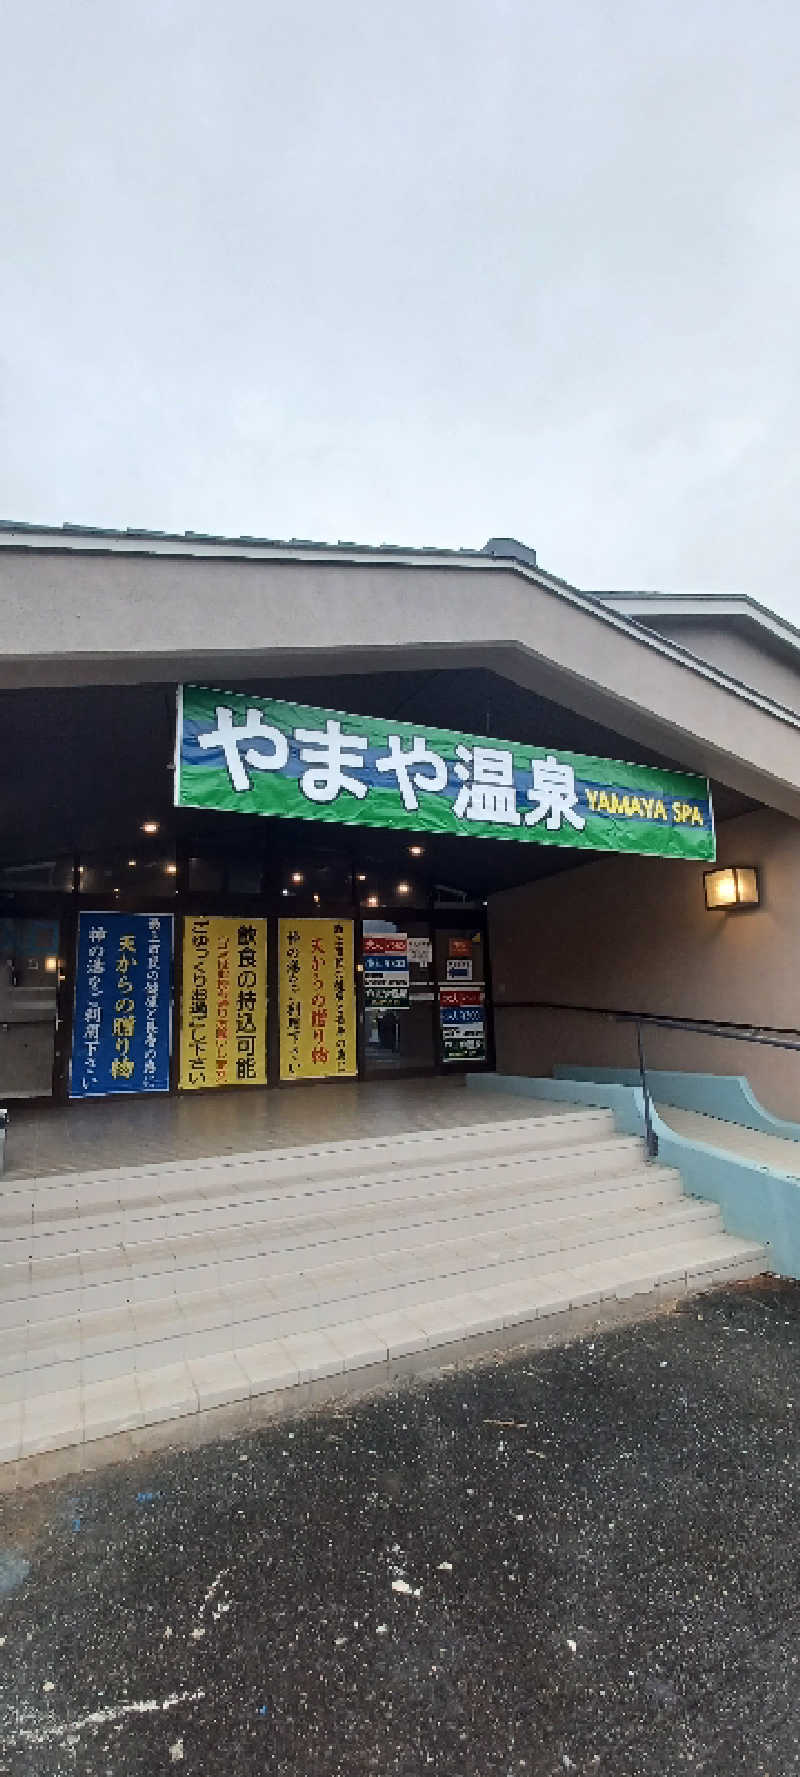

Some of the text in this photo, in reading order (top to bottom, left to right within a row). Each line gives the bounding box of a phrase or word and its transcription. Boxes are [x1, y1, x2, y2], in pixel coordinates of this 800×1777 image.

[197, 706, 587, 832] やまや温泉
[585, 788, 704, 826] YAMAYA SPA
[111, 935, 137, 1081] 天からの贈り物
[235, 924, 257, 1080] 飲食の持込可能
[311, 937, 329, 1065] 天からの贈り物
